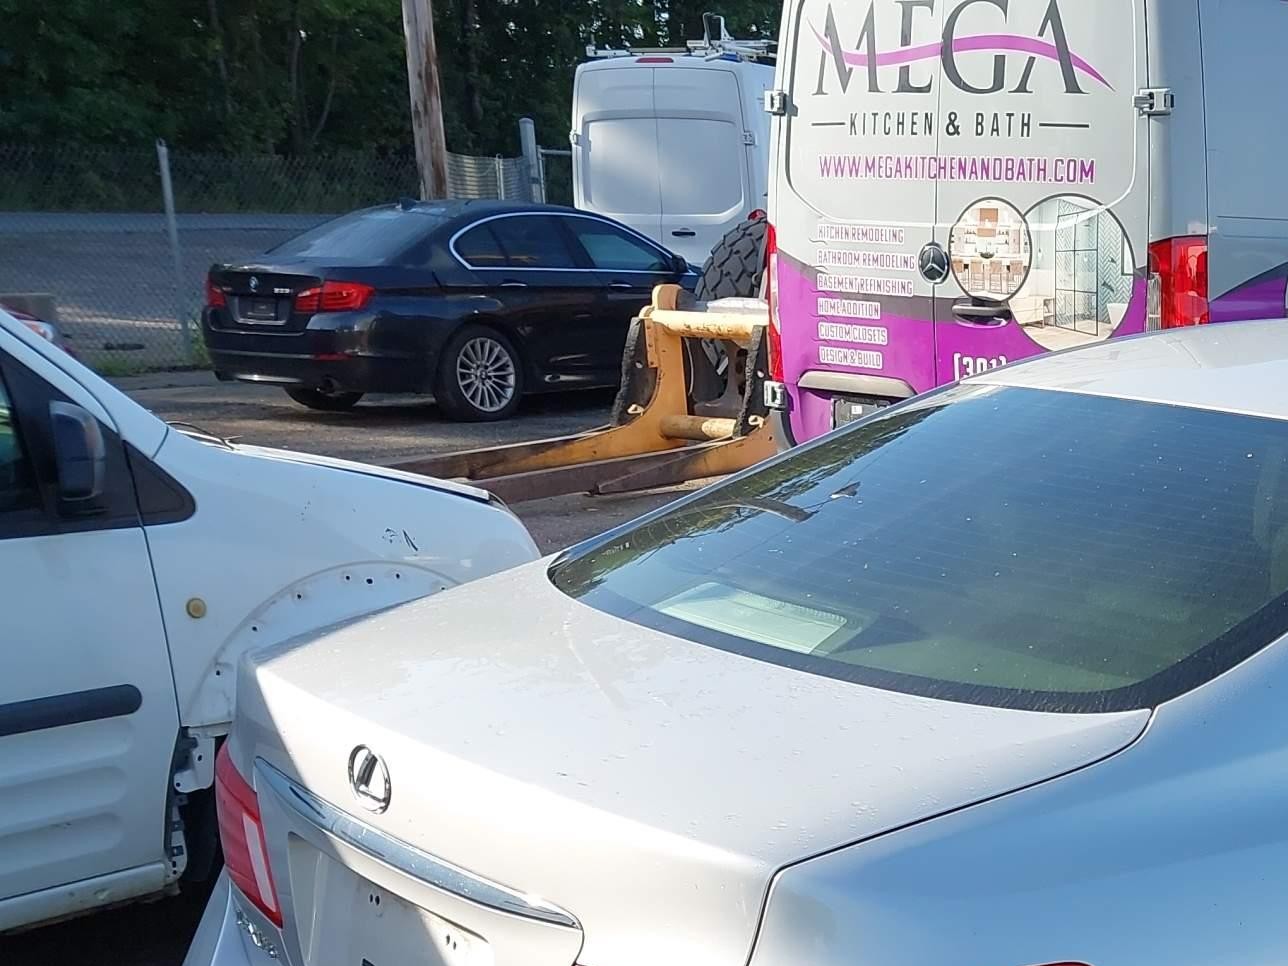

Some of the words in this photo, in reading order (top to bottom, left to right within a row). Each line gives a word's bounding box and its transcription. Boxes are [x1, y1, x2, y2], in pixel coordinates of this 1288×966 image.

[812, 0, 1090, 95] MEGA
[849, 112, 933, 137] KITCHEN
[945, 111, 961, 137] &
[975, 112, 1031, 138] BATH
[819, 154, 1096, 185] WWW.MEGAKITCHENANDBATH.COM
[818, 225, 852, 240] KITCHEN
[851, 226, 905, 244] REMODELING
[818, 250, 860, 266] BATHROOM
[862, 252, 915, 270] REMODELING
[818, 275, 859, 291] BASEMENT
[860, 277, 913, 295] REFINISHING
[819, 299, 841, 314] HOME
[842, 301, 880, 318] ADDITION
[819, 323, 851, 340] CUSTOM
[852, 326, 887, 343] CLOSETS
[821, 347, 849, 363] DESIGN
[849, 350, 857, 364] &
[857, 351, 881, 367] BUILD
